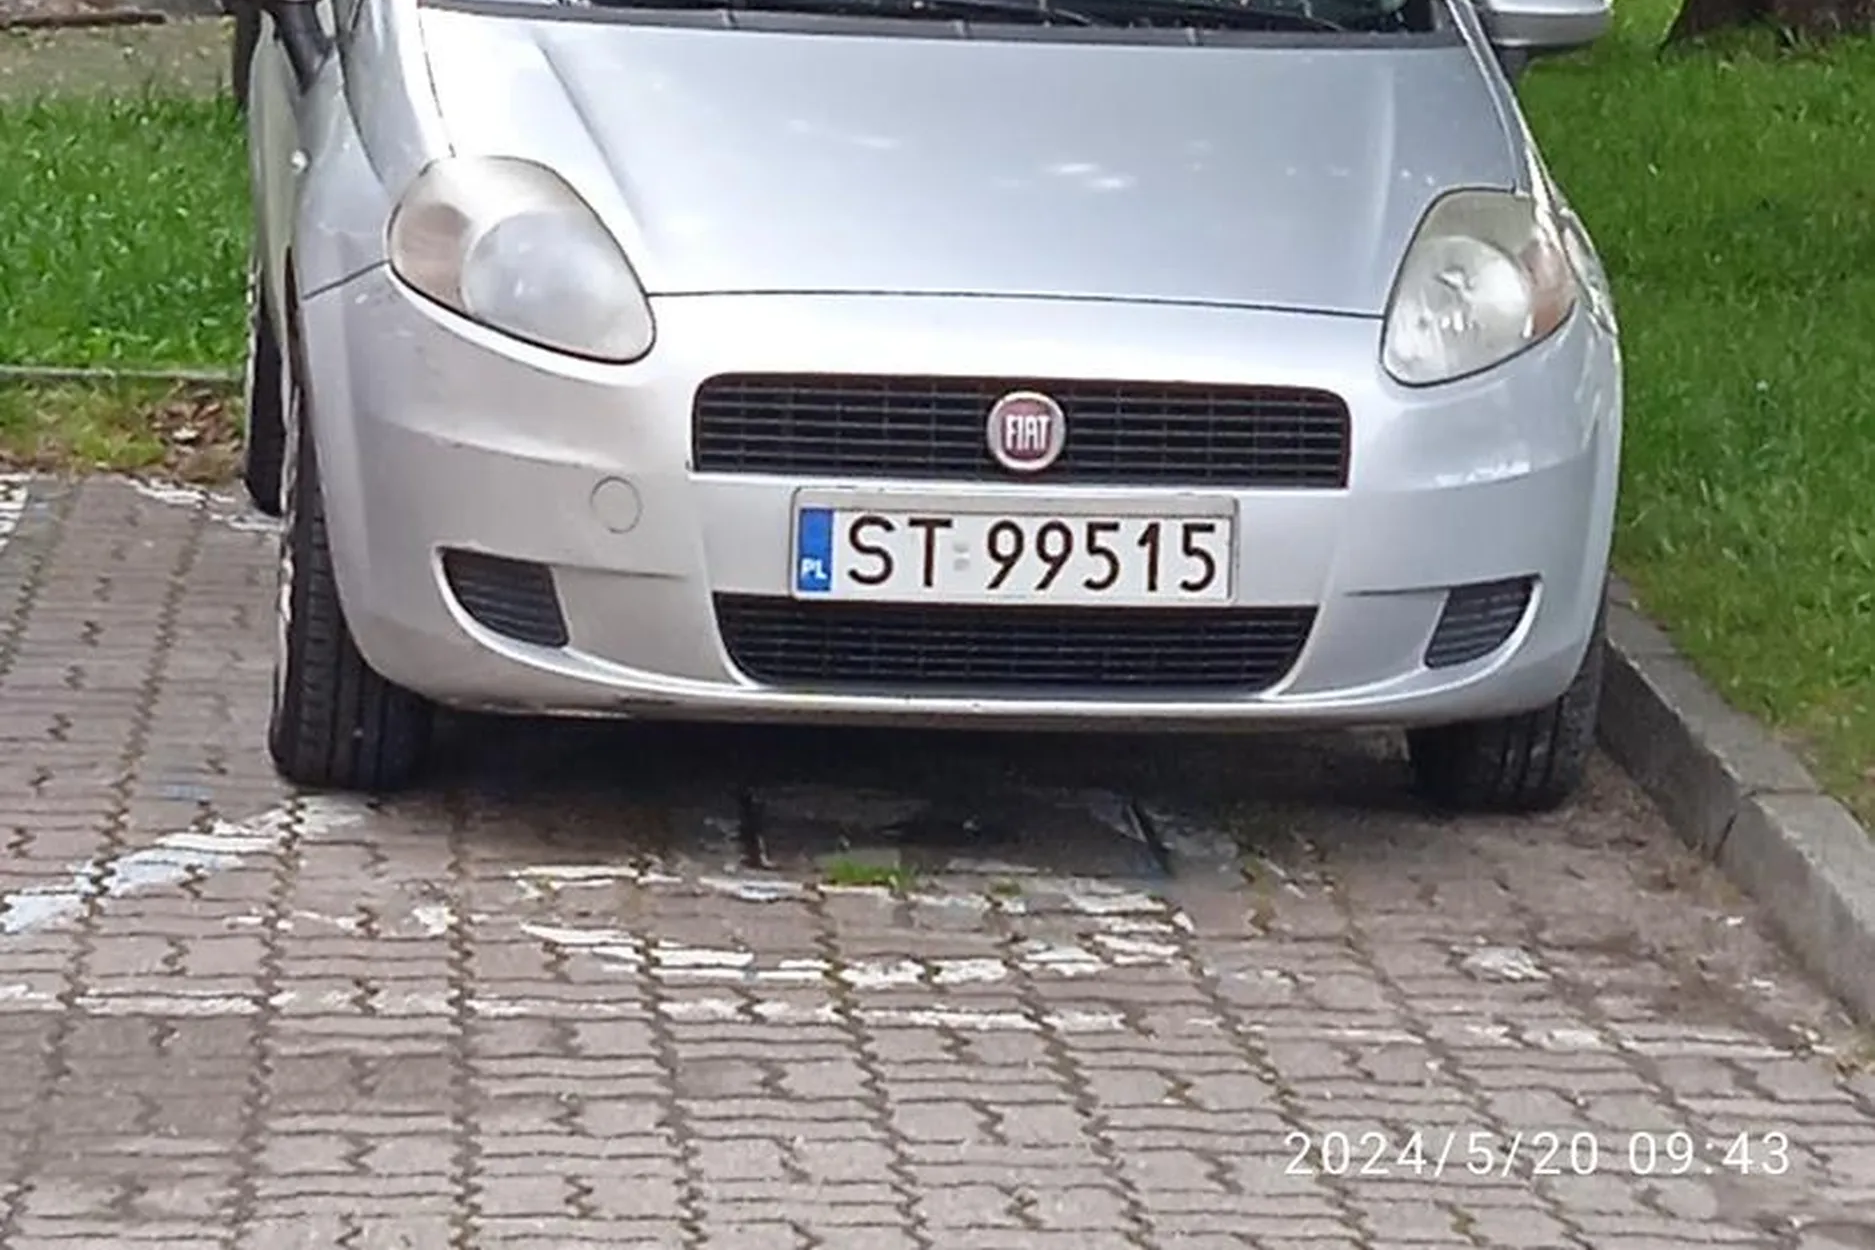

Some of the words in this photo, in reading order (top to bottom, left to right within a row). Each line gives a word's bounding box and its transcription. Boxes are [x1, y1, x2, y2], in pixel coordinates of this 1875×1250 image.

[1005, 414, 1051, 450] FIAT
[801, 558, 828, 579] PL
[848, 516, 952, 587] ST
[986, 519, 1216, 593] 99515
